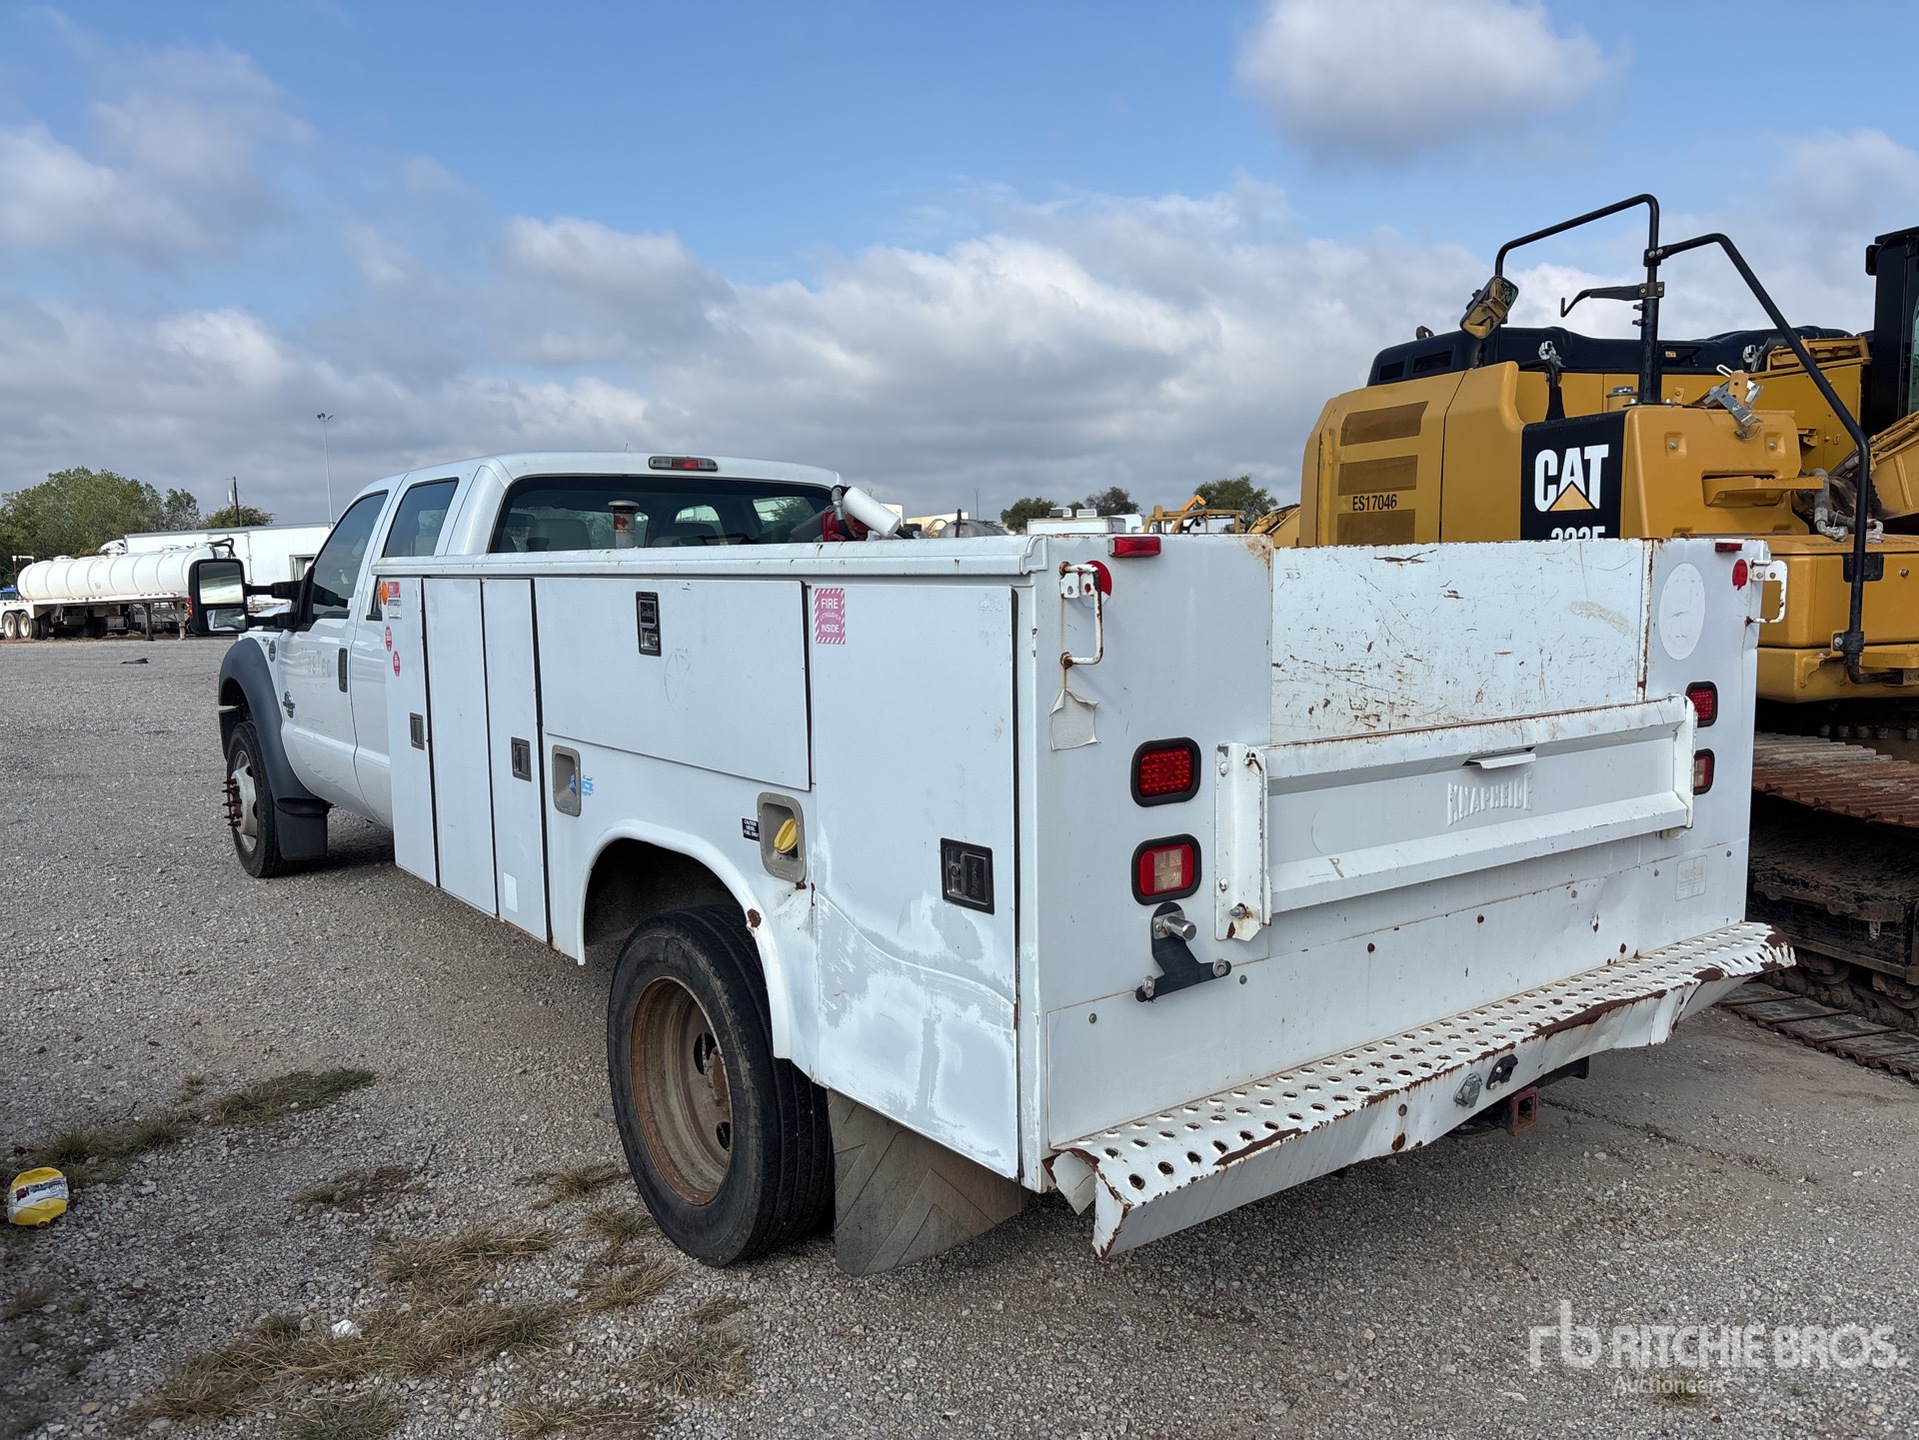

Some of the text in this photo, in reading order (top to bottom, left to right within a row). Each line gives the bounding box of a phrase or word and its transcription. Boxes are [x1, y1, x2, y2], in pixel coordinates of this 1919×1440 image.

[1534, 444, 1609, 512] CAT
[1352, 494, 1397, 511] ES17046
[821, 598, 839, 609] FIRE
[821, 624, 840, 633] INSIDE
[1447, 771, 1532, 826] KNAPHEIDE
